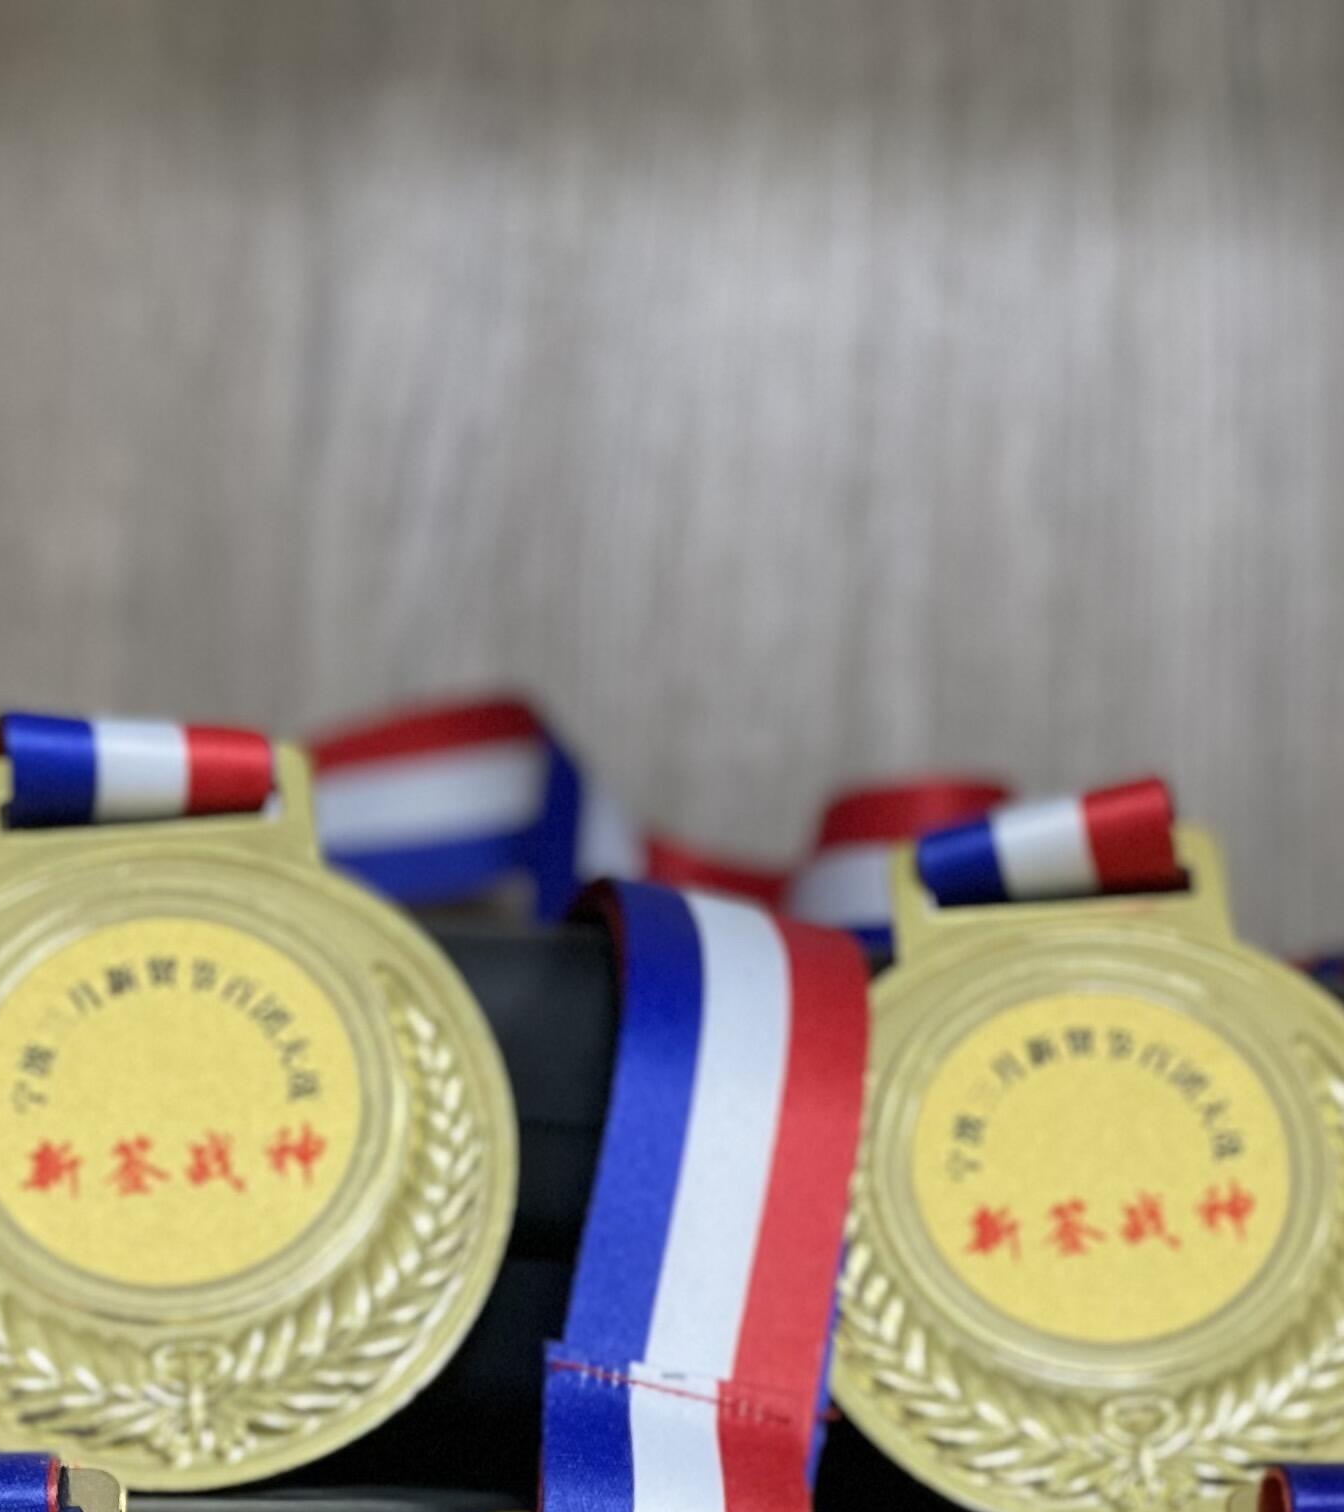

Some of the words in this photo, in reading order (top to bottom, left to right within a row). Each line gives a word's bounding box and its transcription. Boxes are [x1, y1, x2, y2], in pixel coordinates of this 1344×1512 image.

[12, 958, 322, 1112] 宁波月新贸节百团大战
[23, 1123, 327, 1197] 新签战神
[947, 1027, 1244, 1180] 宁波月新贸节百团大战
[967, 1180, 1254, 1259] 新签战神
